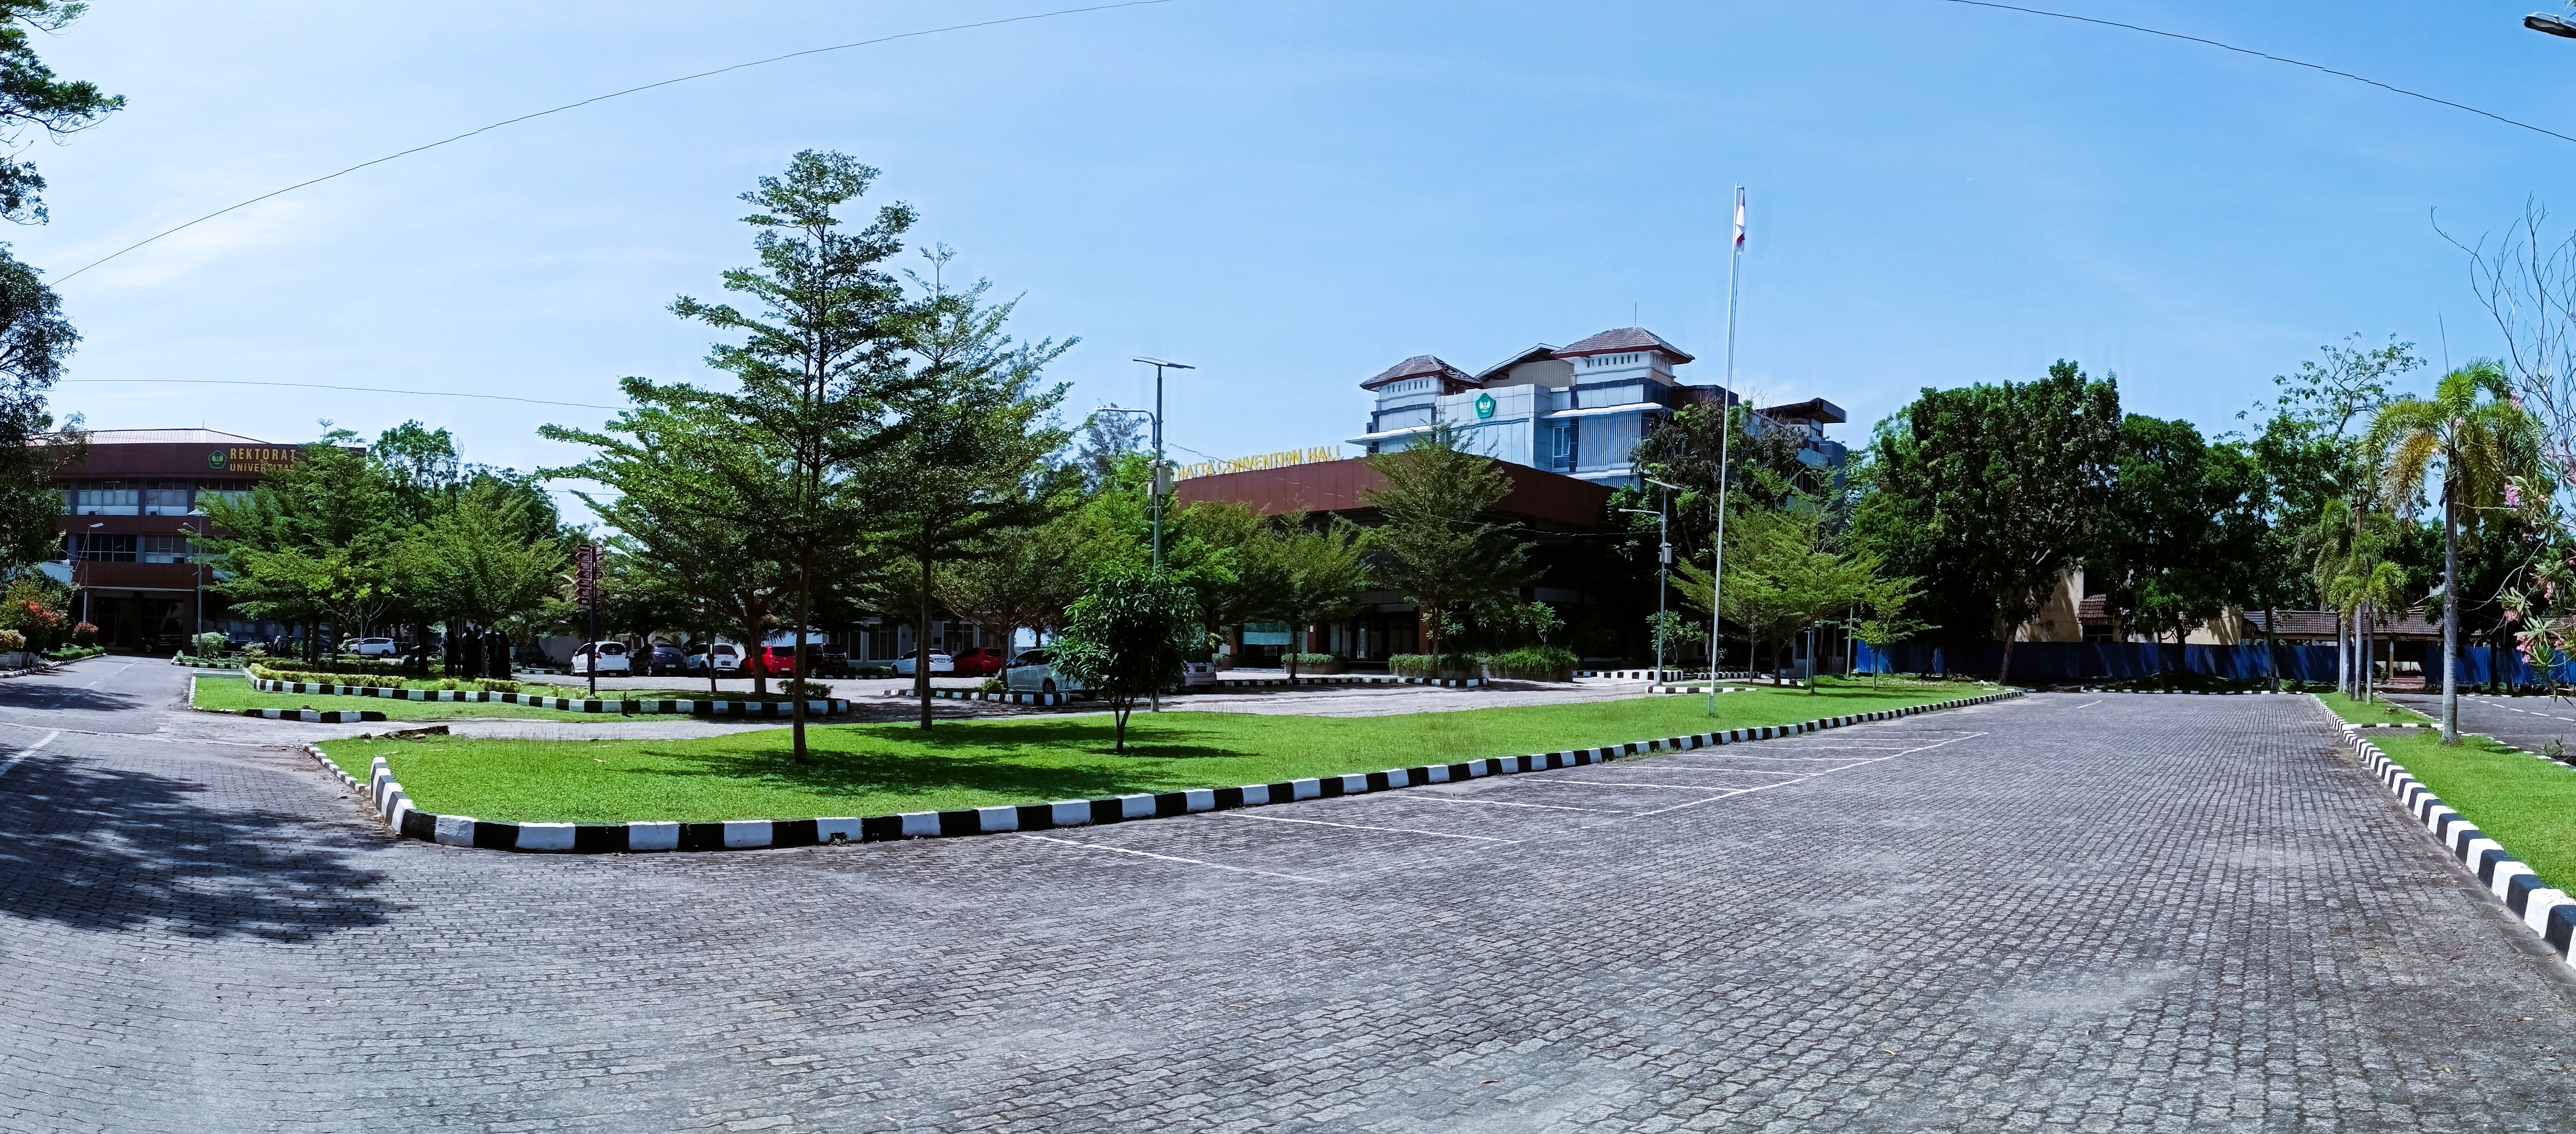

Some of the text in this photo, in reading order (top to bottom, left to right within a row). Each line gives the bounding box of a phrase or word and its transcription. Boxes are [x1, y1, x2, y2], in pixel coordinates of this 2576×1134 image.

[230, 448, 296, 461] REKTORAT
[1176, 445, 1344, 480] HATTA CONVENTION HALL
